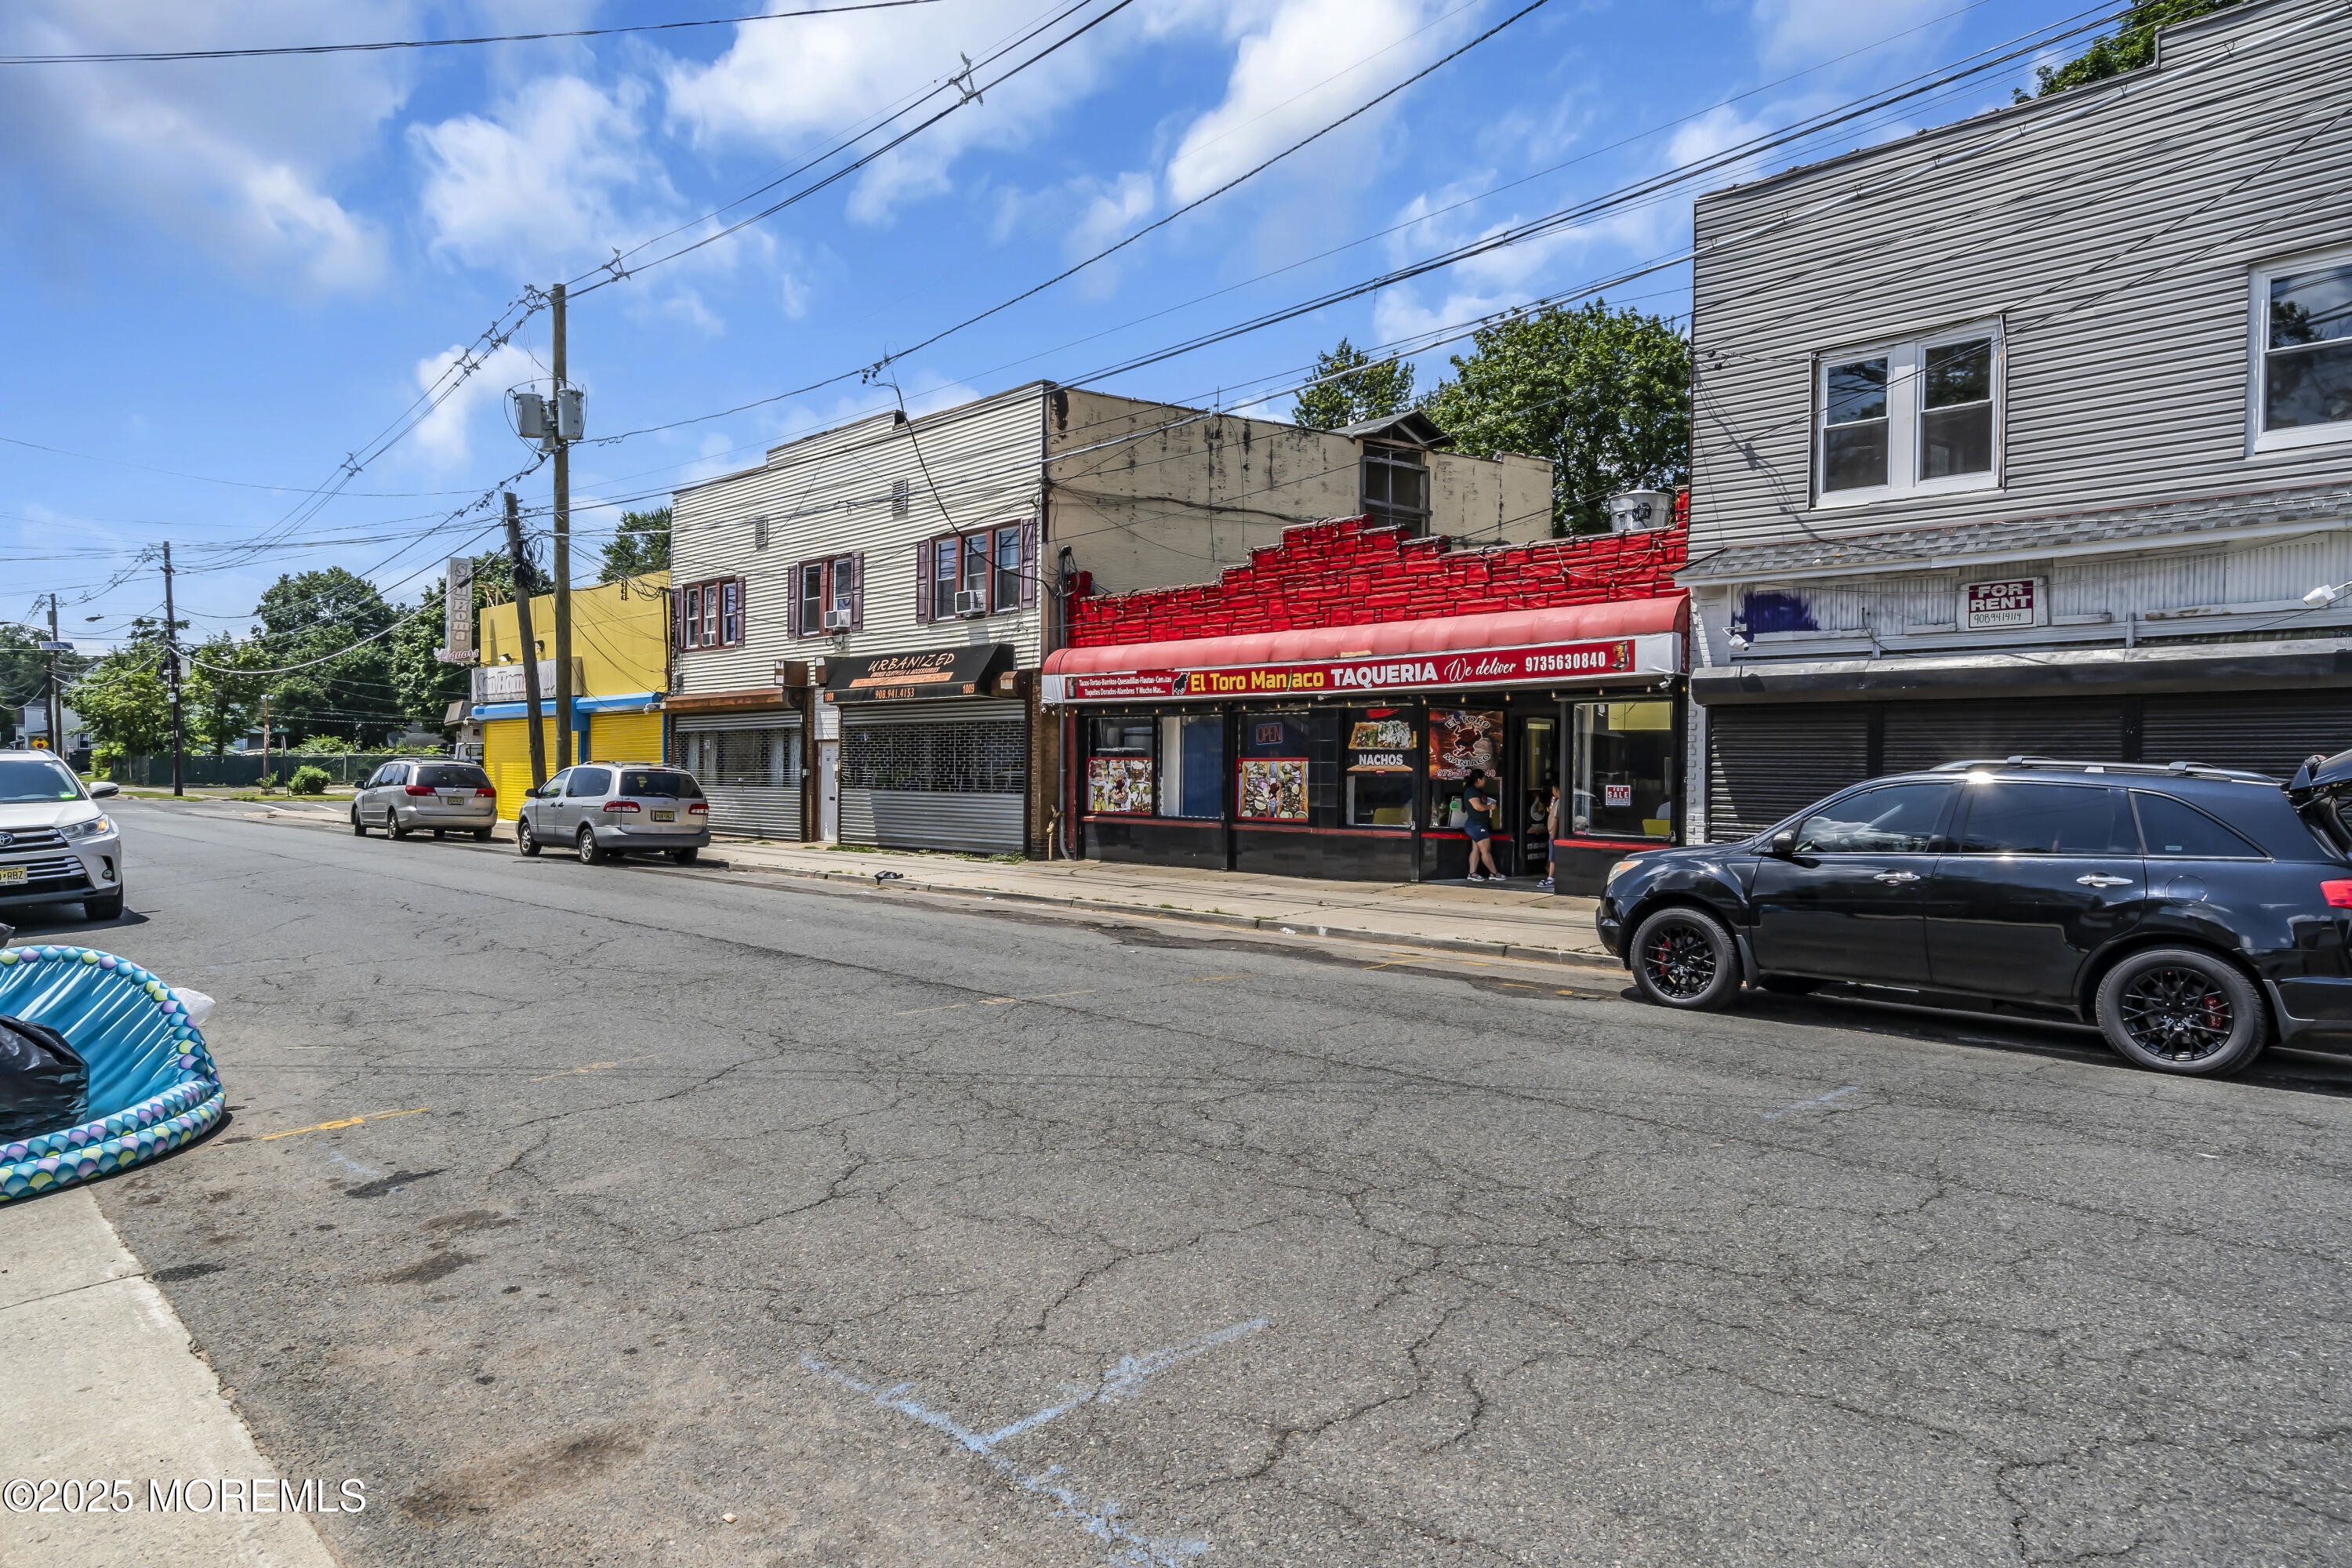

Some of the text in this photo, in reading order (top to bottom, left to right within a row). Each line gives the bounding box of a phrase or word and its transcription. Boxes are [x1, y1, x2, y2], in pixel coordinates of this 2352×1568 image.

[1978, 583, 2023, 597] FOR
[1971, 596, 2031, 611] RENT
[868, 653, 954, 672] URBANIZED
[1443, 657, 1516, 681] We deliver
[1525, 652, 1606, 672] 9735630840
[1191, 673, 1206, 691] El
[1210, 673, 1246, 691] Toro
[1331, 662, 1439, 688] TAQUERIA
[875, 688, 915, 699] 908.941.4153
[963, 684, 975, 694] 1009
[1085, 688, 1101, 697] Taquitos
[825, 692, 834, 702] 1009
[1445, 715, 1491, 729] EL TORO
[1258, 725, 1282, 742] OPEN
[1359, 754, 1403, 766] NACHOS
[1443, 753, 1491, 767] MANIACO
